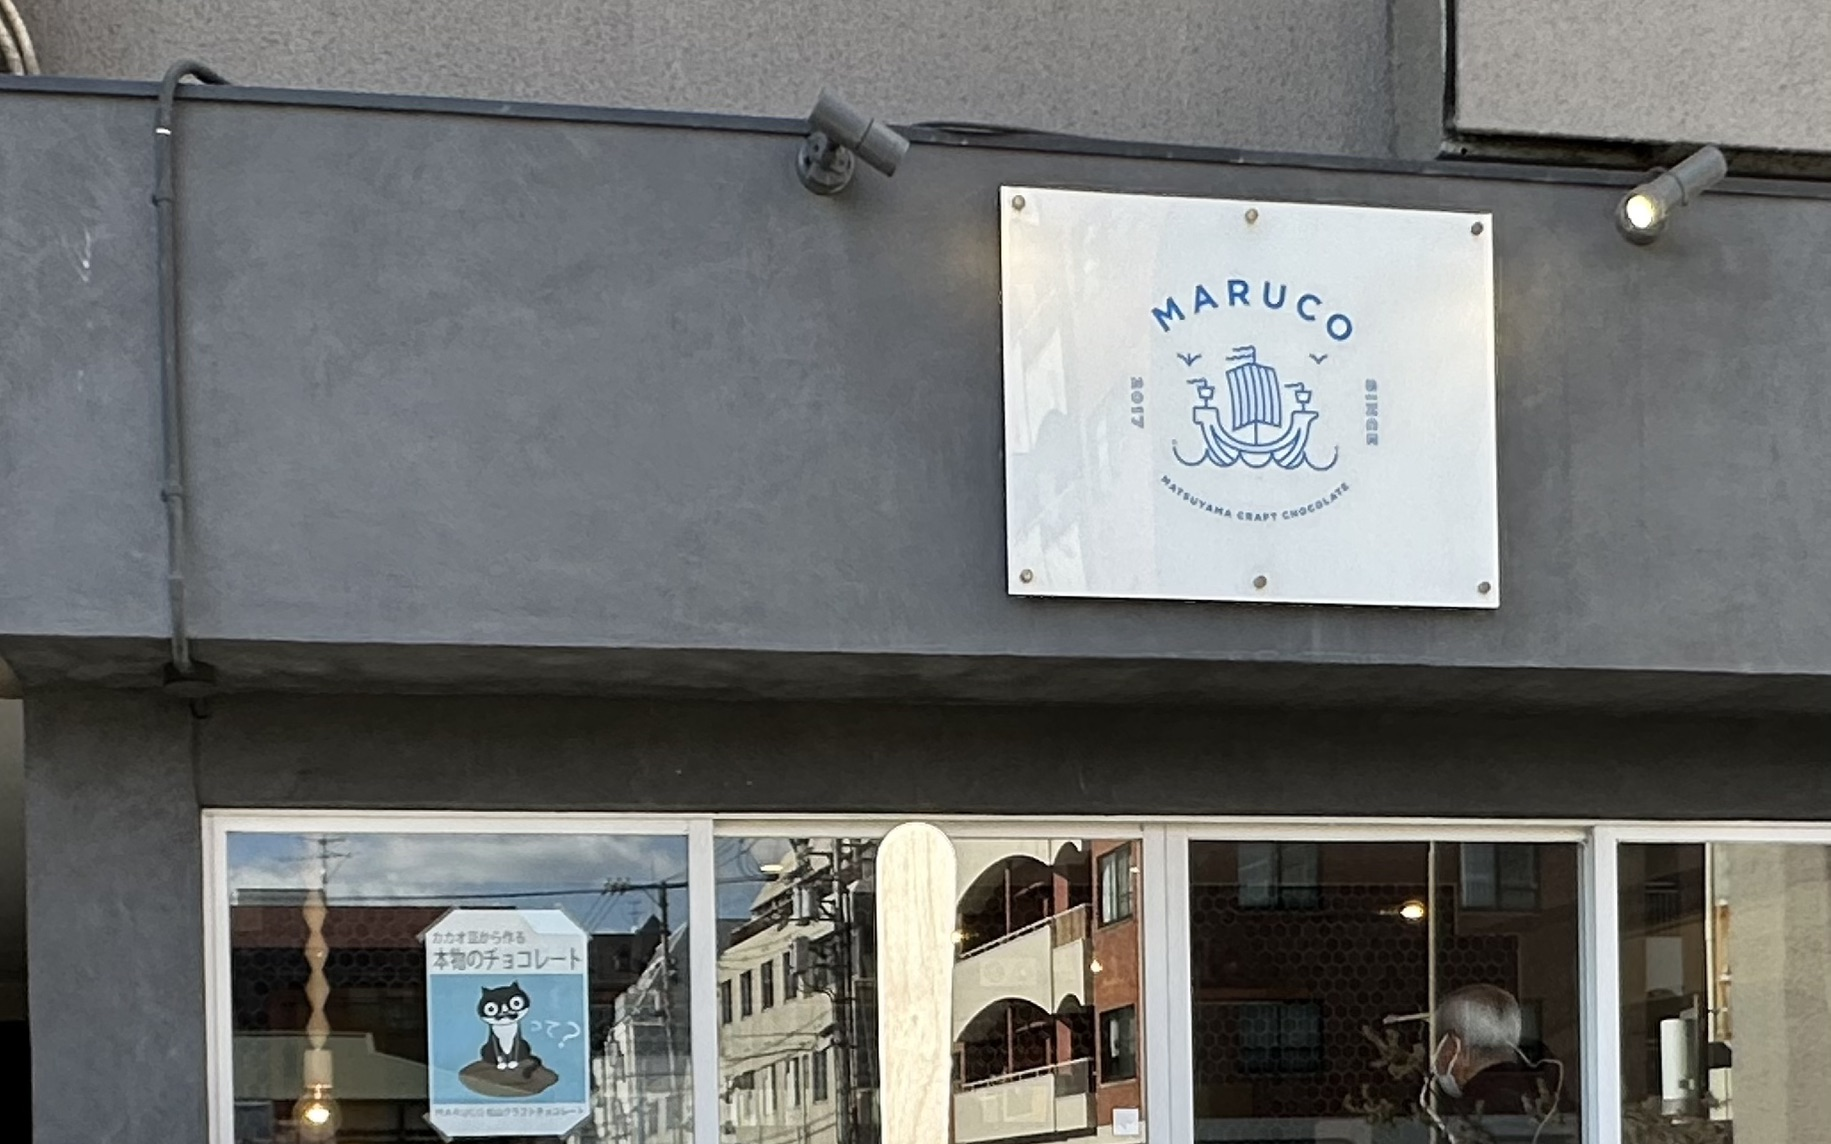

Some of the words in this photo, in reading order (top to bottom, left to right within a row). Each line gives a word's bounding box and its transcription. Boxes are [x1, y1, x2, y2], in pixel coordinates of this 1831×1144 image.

[1151, 279, 1353, 341] MARUCO
[1131, 376, 1144, 429] 2017
[1365, 379, 1379, 446] SINCE
[1160, 475, 1232, 519] MATSUYAMA
[1236, 511, 1278, 522] CRAFT
[1282, 482, 1350, 520] CHOCOLATE
[433, 947, 583, 971] 本物のチョコレート
